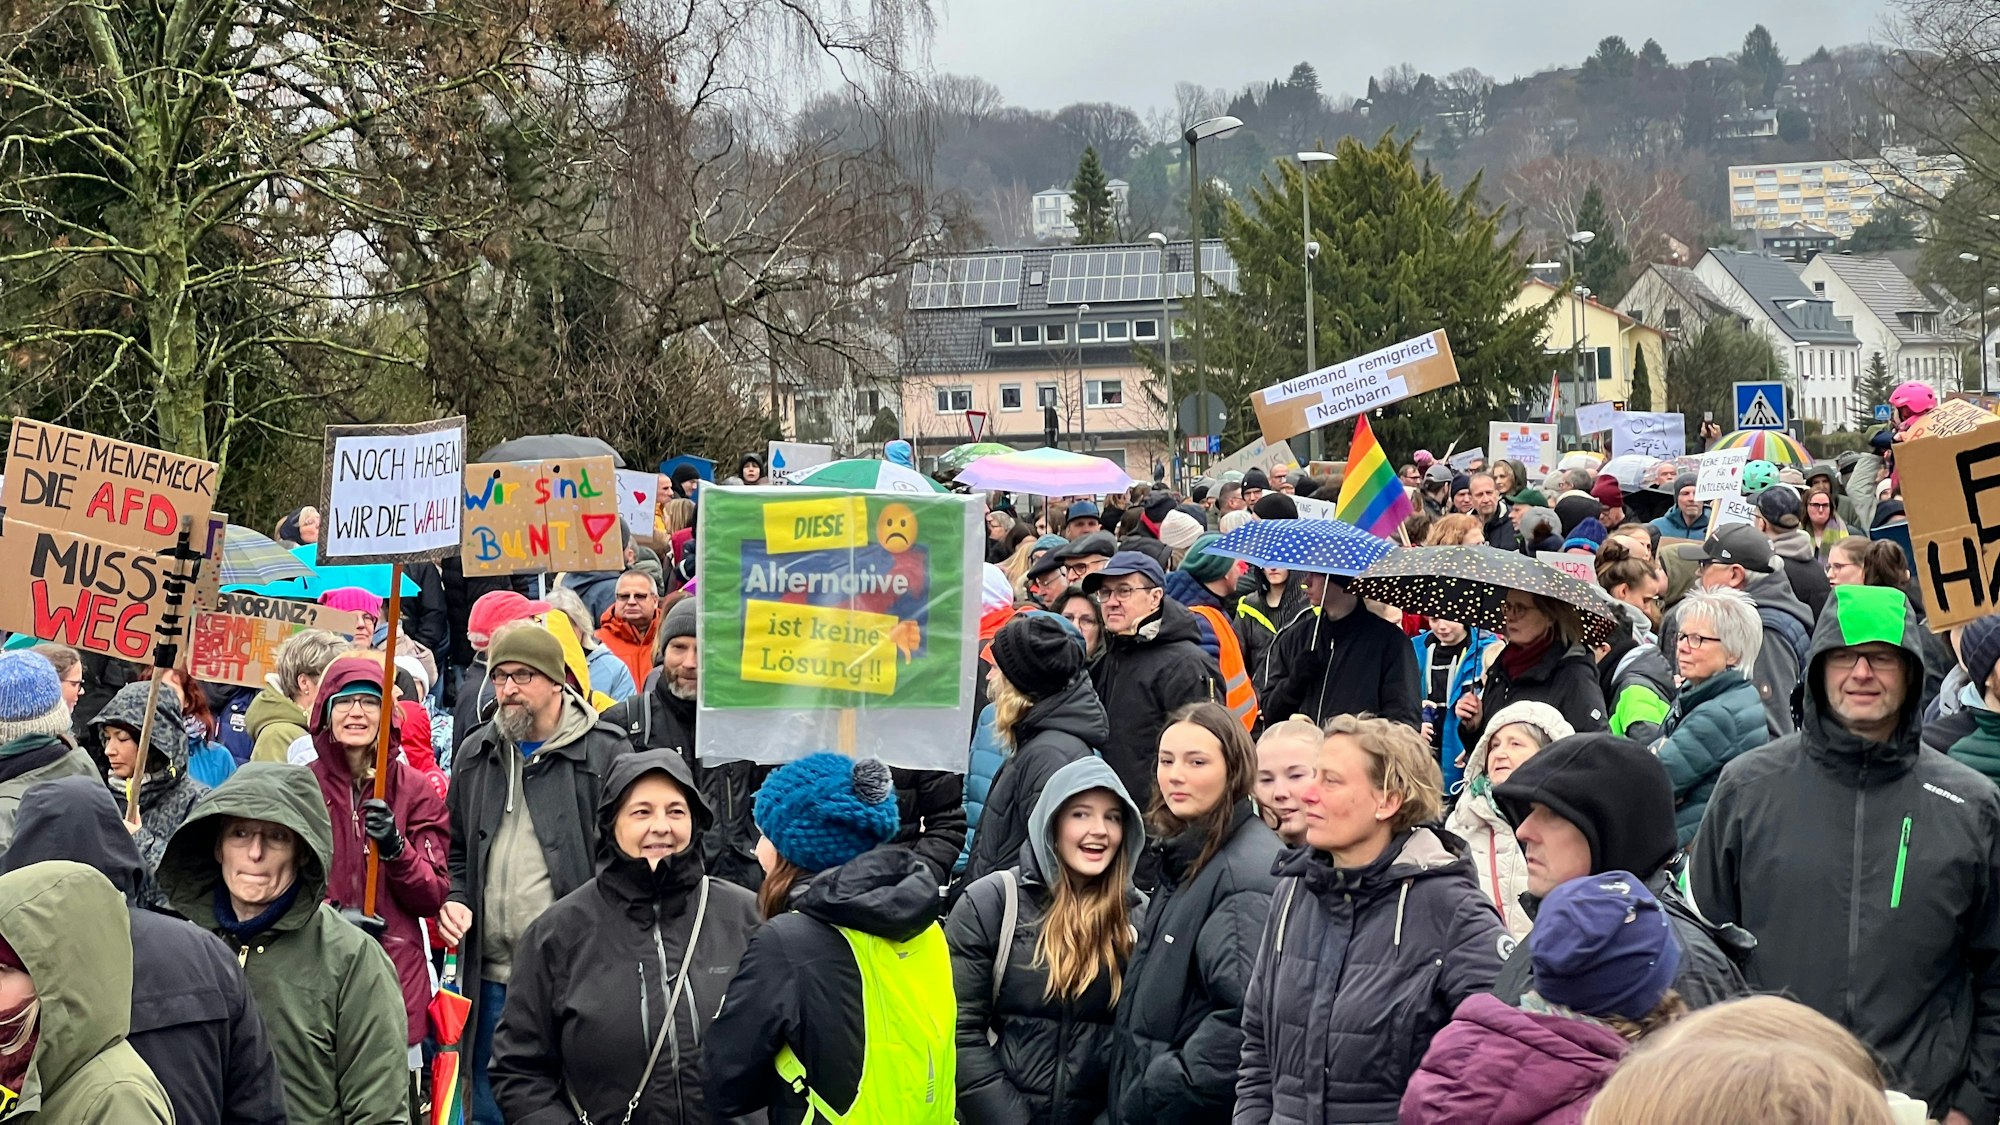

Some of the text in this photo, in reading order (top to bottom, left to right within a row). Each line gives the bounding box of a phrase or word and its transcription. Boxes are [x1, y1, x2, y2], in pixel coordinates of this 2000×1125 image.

[1282, 337, 1434, 396] Niemand remigriert
[1332, 375, 1377, 397] meine
[1316, 385, 1391, 419] Nachbarn
[340, 440, 460, 481] NOCH HABEN
[20, 467, 177, 535] DIE AFD
[535, 465, 602, 505] sind
[335, 496, 456, 539] WIR DIE WAHL!
[794, 513, 845, 540] DIESE
[30, 533, 157, 601] MUSS
[745, 560, 909, 595] Alternative
[31, 579, 151, 658] WEG
[216, 593, 318, 626] GNORANZ?
[768, 612, 880, 646] ist keine
